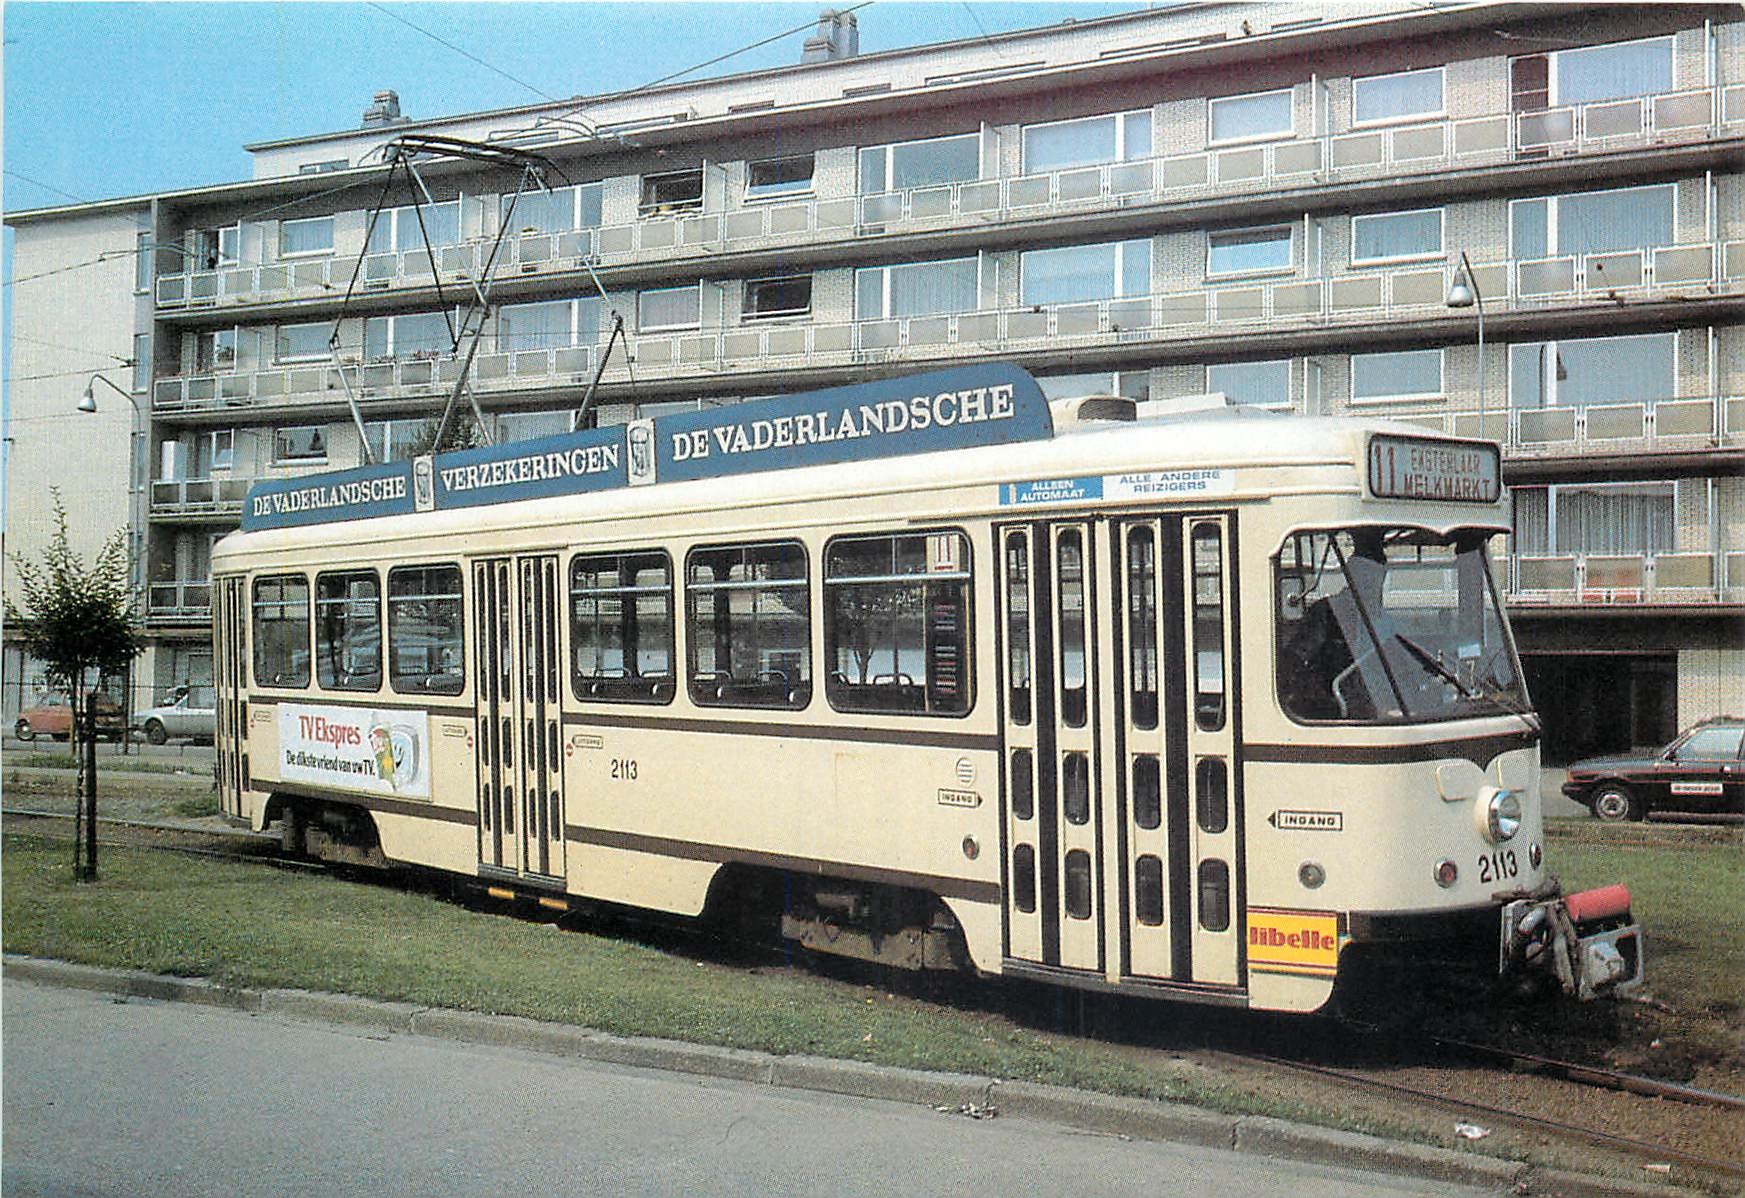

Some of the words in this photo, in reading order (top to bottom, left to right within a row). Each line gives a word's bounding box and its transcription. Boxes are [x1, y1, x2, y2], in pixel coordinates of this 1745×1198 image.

[672, 431, 710, 462] DE
[713, 383, 1015, 454] VADERLANDSCHE
[440, 444, 620, 492] VERZEKERINGEN
[1119, 474, 1152, 485] ALLE
[1160, 470, 1222, 482] ANDERE
[1374, 444, 1396, 498] 11
[253, 496, 271, 517] DE
[273, 476, 407, 514] VADERLANDSCHE
[1020, 489, 1085, 502] AUTOMAAT
[1031, 480, 1074, 491] ALLEEN
[1133, 481, 1207, 493] REIZIGERS
[1404, 473, 1491, 501] MELKMARKT
[315, 717, 361, 750] Ekspres
[286, 750, 296, 765] De
[339, 760, 352, 773] van
[363, 760, 375, 776] TV.
[610, 759, 638, 780] 2113
[1284, 815, 1336, 827] INGANG
[1478, 849, 1518, 884] 2113
[1249, 926, 1335, 951] libelle
